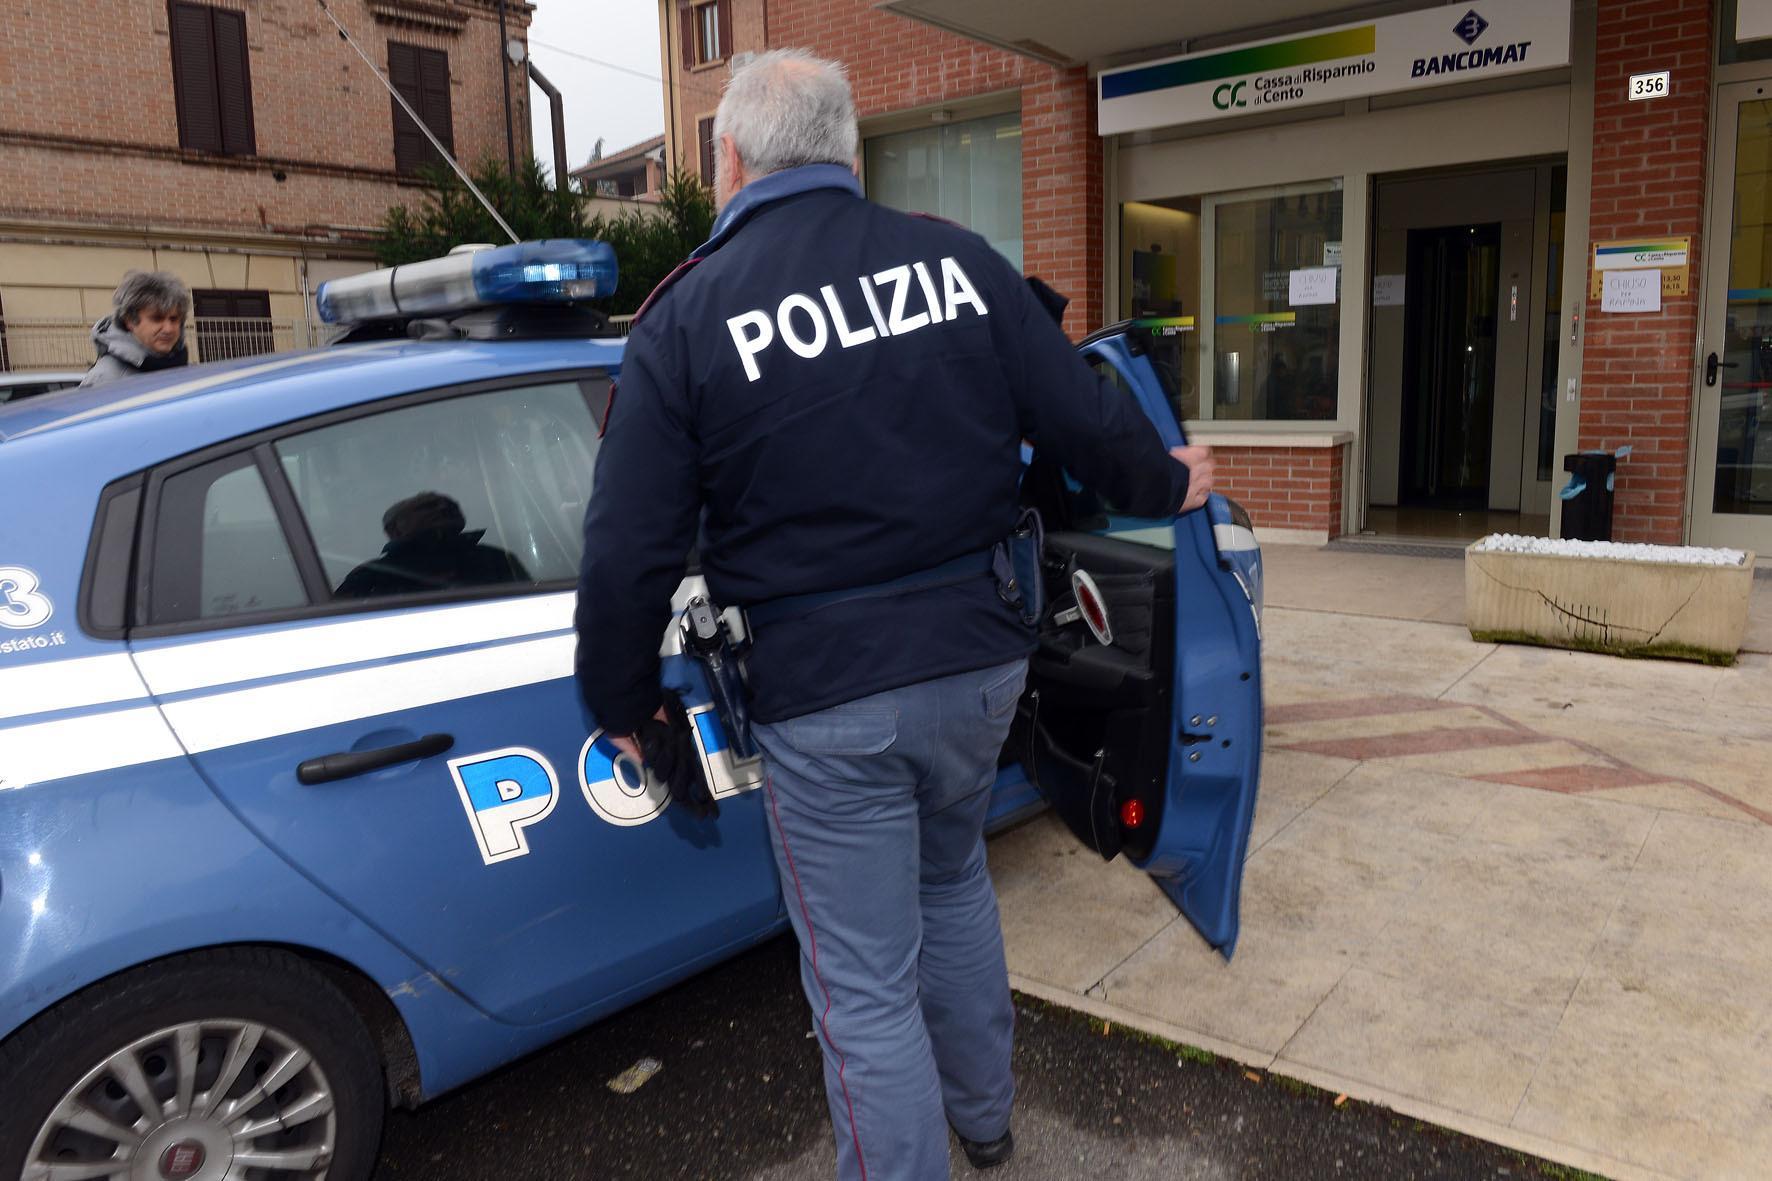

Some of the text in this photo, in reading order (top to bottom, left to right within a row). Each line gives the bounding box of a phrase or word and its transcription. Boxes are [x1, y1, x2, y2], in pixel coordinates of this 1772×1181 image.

[1411, 41, 1532, 78] BANCOMAT
[1254, 75, 1293, 91] Cassa
[1303, 59, 1376, 84] Risparmio
[1635, 77, 1664, 95] 356
[1254, 86, 1304, 105] di Cento
[726, 256, 989, 382] POLIZIA
[0, 631, 66, 654] stato.it
